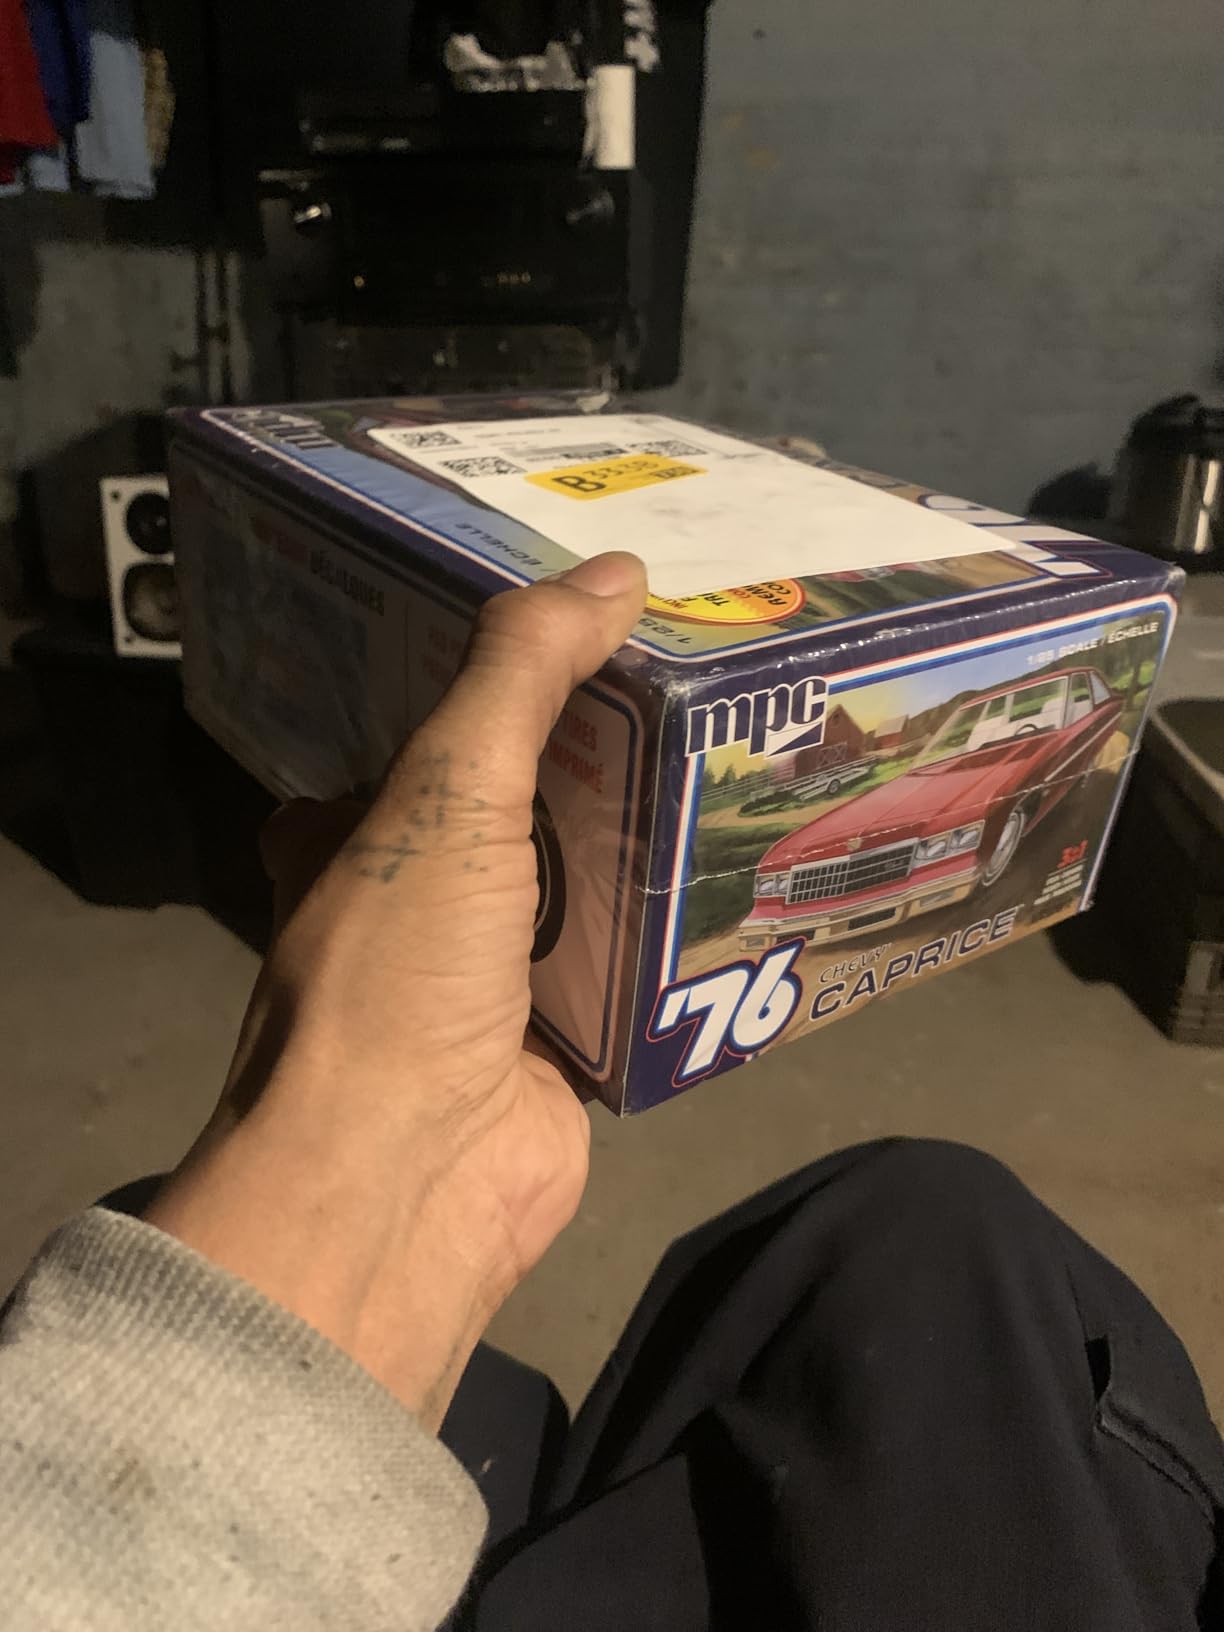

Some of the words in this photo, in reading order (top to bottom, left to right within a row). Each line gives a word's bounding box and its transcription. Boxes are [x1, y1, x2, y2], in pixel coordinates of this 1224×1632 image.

[552, 475, 607, 493] B
[685, 675, 829, 760] mpc
[808, 907, 1018, 1022] CAPRICE
